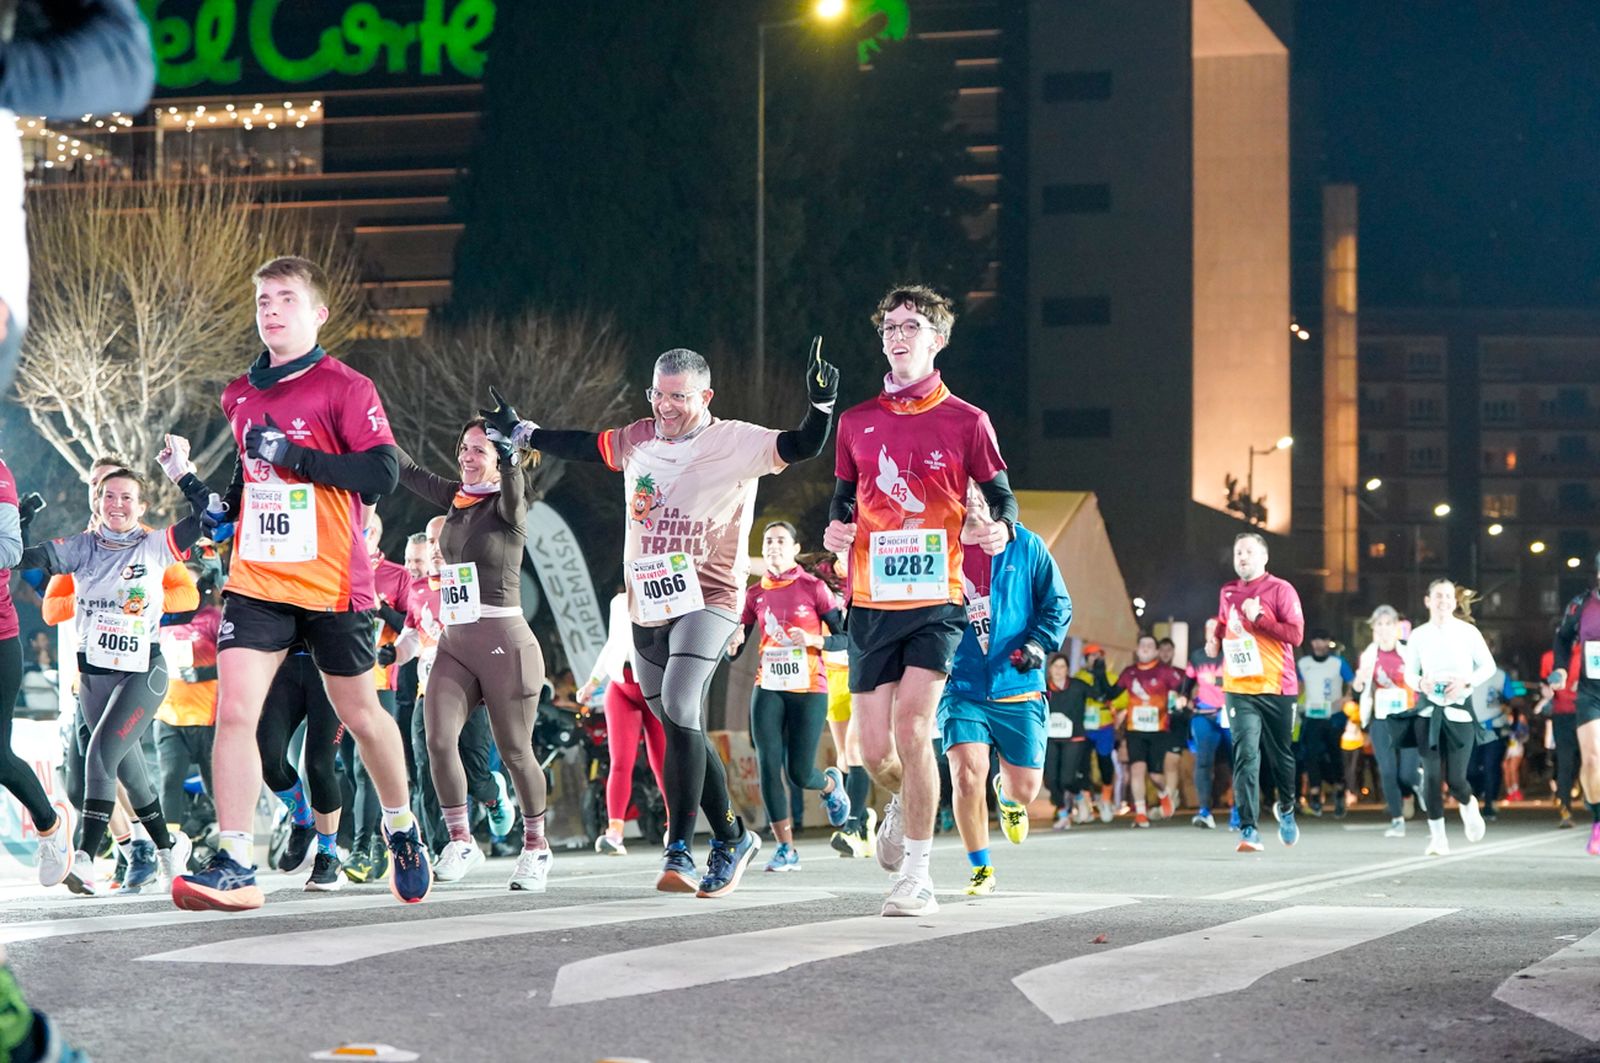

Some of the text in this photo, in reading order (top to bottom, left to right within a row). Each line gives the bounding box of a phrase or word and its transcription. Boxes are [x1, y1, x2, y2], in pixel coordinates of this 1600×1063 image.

[249, 0, 497, 82] Corte
[891, 483, 907, 502] 43
[664, 508, 679, 519] LA
[259, 513, 290, 535] 146
[656, 515, 704, 536] PIÑA
[641, 536, 703, 556] TRAIL
[878, 547, 893, 555] SAN
[884, 554, 934, 576] 8282
[442, 585, 469, 605] 064
[552, 529, 604, 647] JAPEMASA
[643, 573, 686, 599] 4066
[89, 598, 116, 608] PIÑA
[971, 617, 991, 636] 66
[98, 633, 139, 652] 4065
[1230, 652, 1251, 664] 031
[770, 662, 800, 676] 4008
